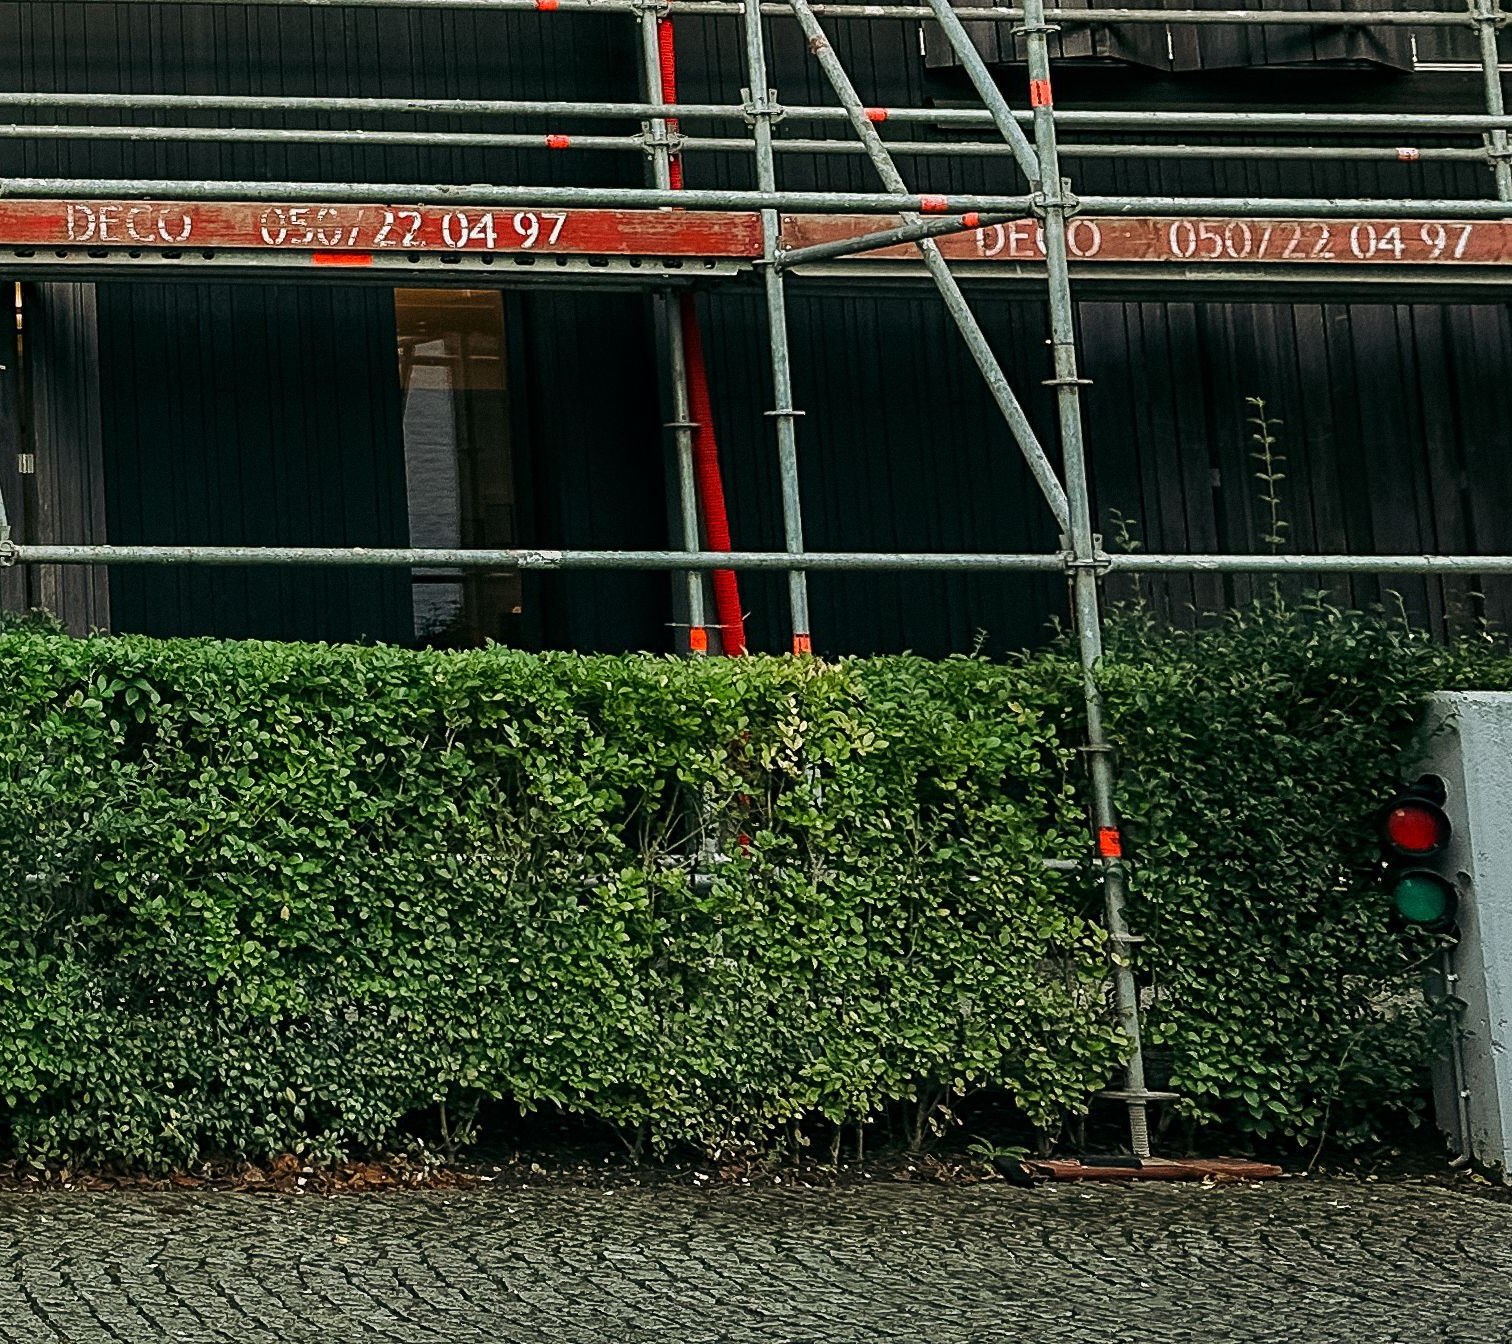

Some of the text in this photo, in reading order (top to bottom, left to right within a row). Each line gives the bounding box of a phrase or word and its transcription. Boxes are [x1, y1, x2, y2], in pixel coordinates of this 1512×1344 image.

[66, 205, 192, 243] DECO
[441, 212, 497, 248] 04
[513, 212, 566, 248] 97
[1170, 220, 1336, 259] 050/22
[1350, 224, 1405, 259] 04
[1419, 224, 1474, 259] 97
